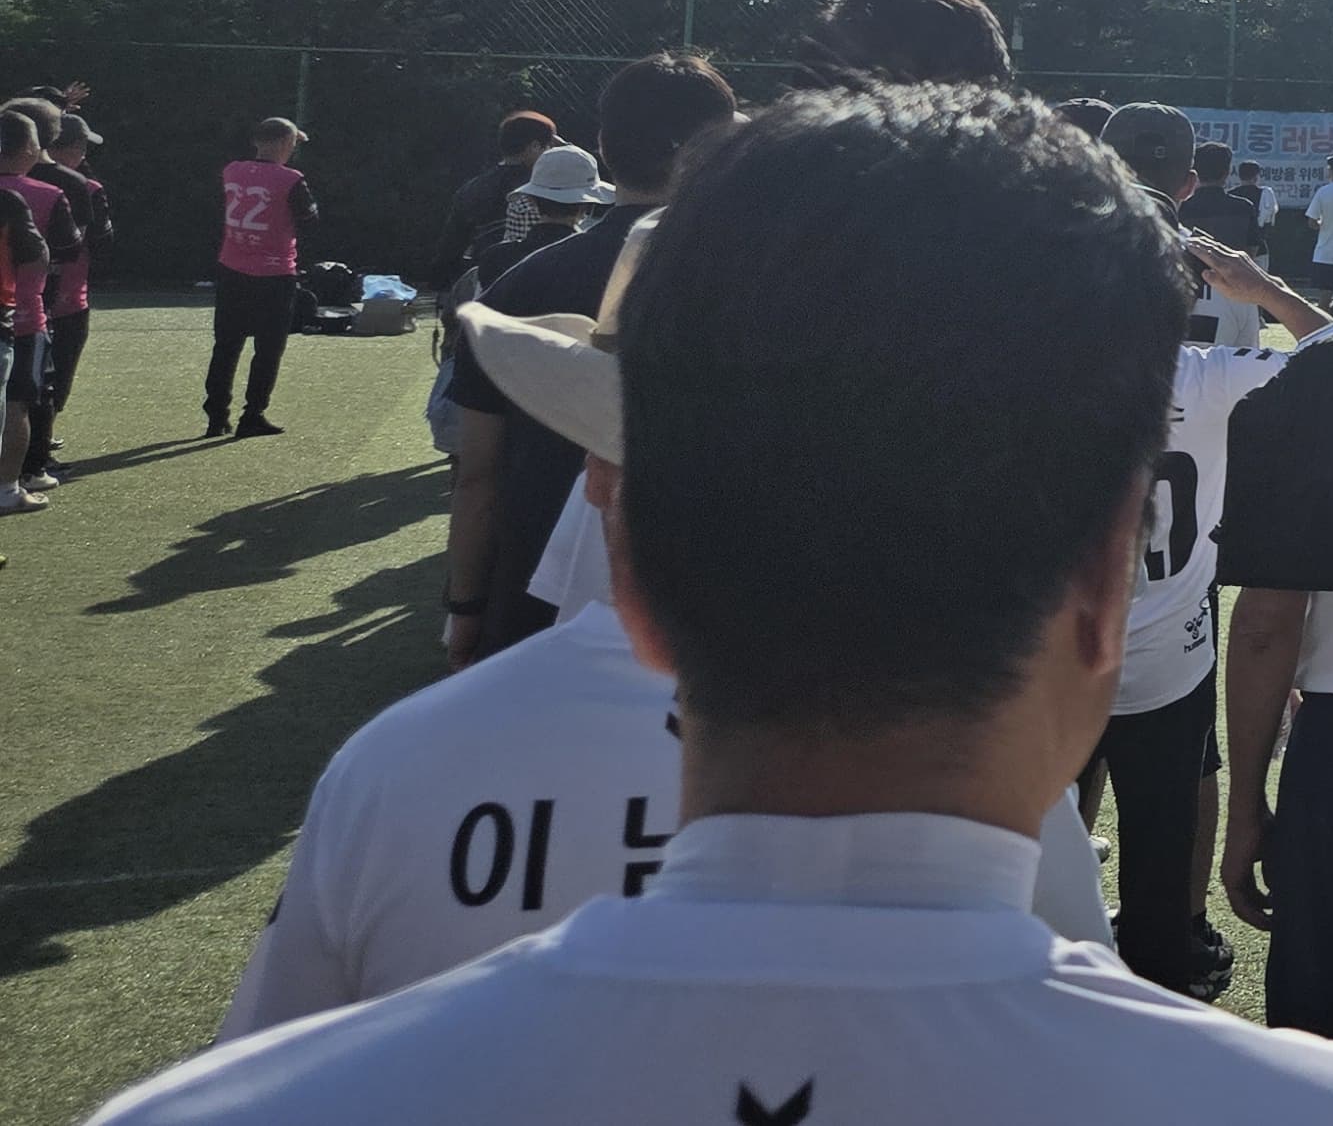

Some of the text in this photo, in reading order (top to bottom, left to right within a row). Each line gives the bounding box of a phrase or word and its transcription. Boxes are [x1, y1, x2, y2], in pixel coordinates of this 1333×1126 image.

[1249, 124, 1274, 153] 중
[224, 182, 271, 231] 22
[450, 800, 555, 910] 이
